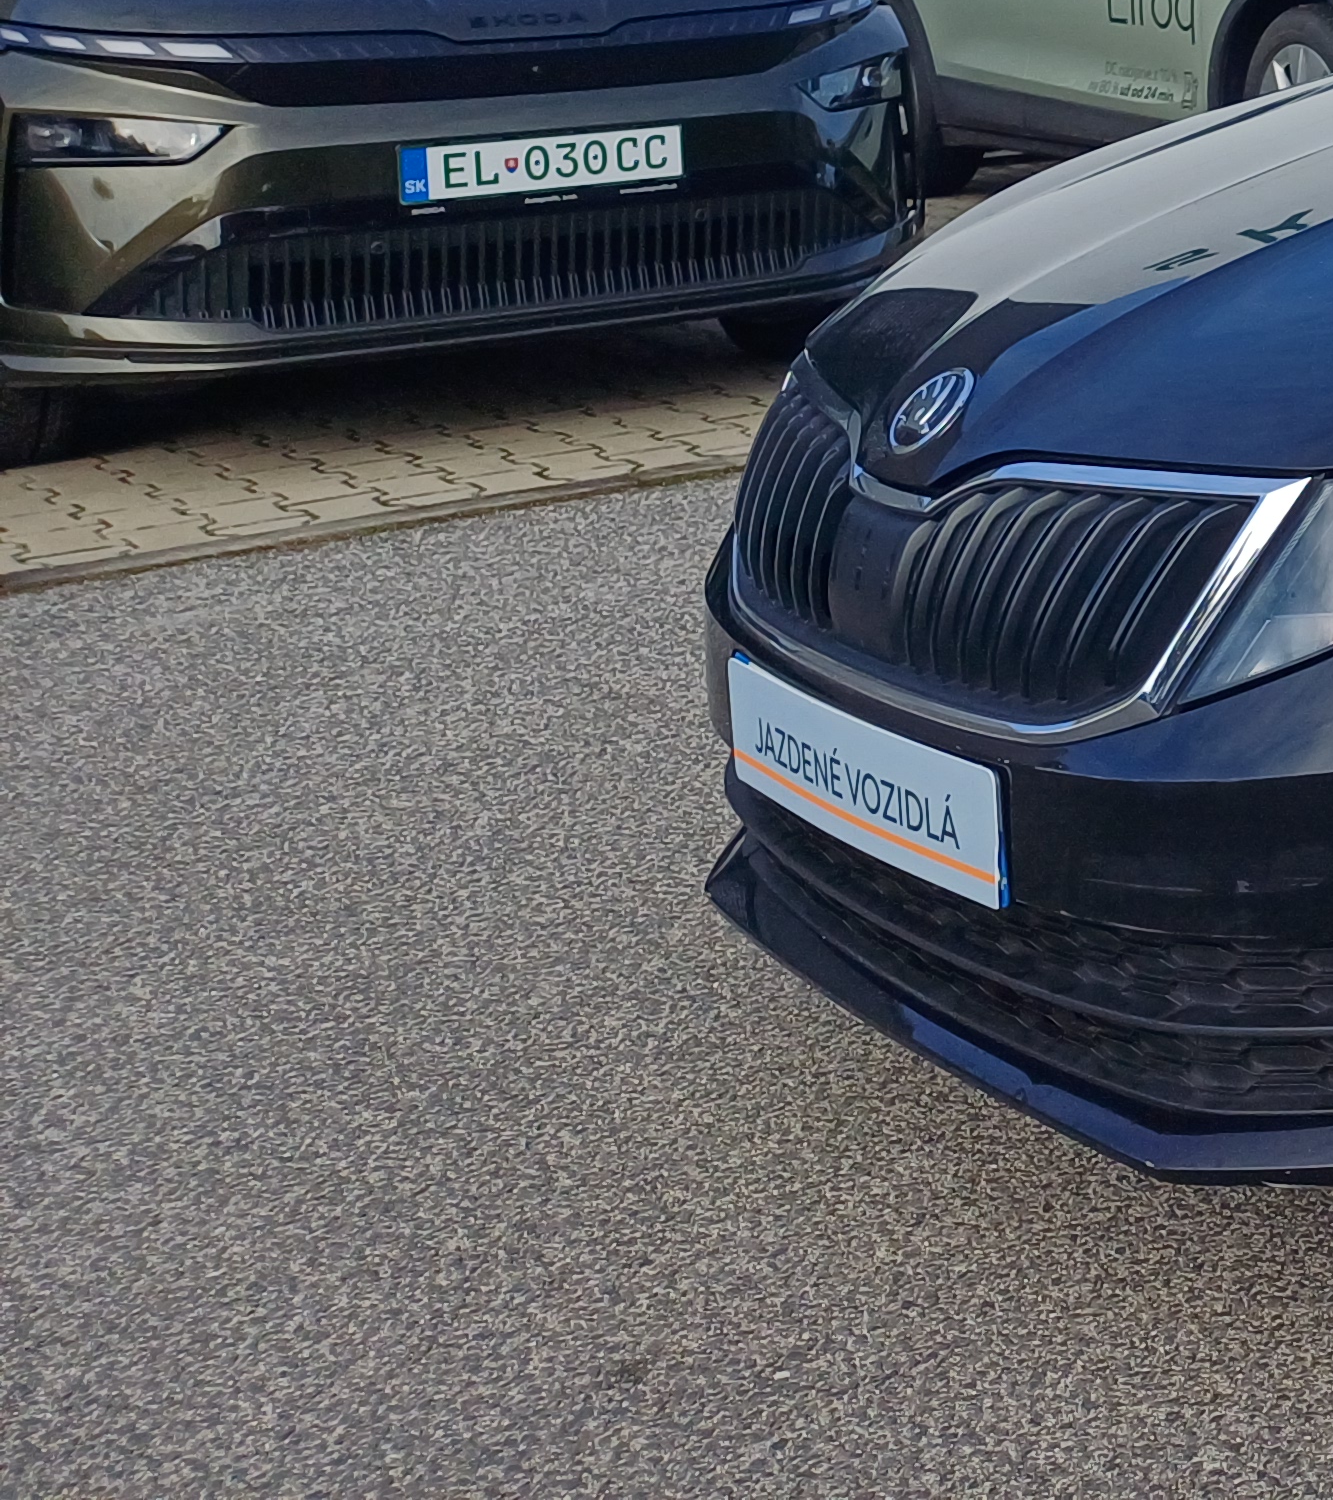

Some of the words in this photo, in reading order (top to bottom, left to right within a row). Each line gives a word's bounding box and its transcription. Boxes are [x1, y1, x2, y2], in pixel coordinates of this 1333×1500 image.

[404, 179, 427, 195] SK
[442, 151, 500, 190] EL
[523, 134, 668, 181] 030CC
[755, 717, 844, 799] JAZDENÉ
[845, 761, 961, 850] VOZIDLÁ
